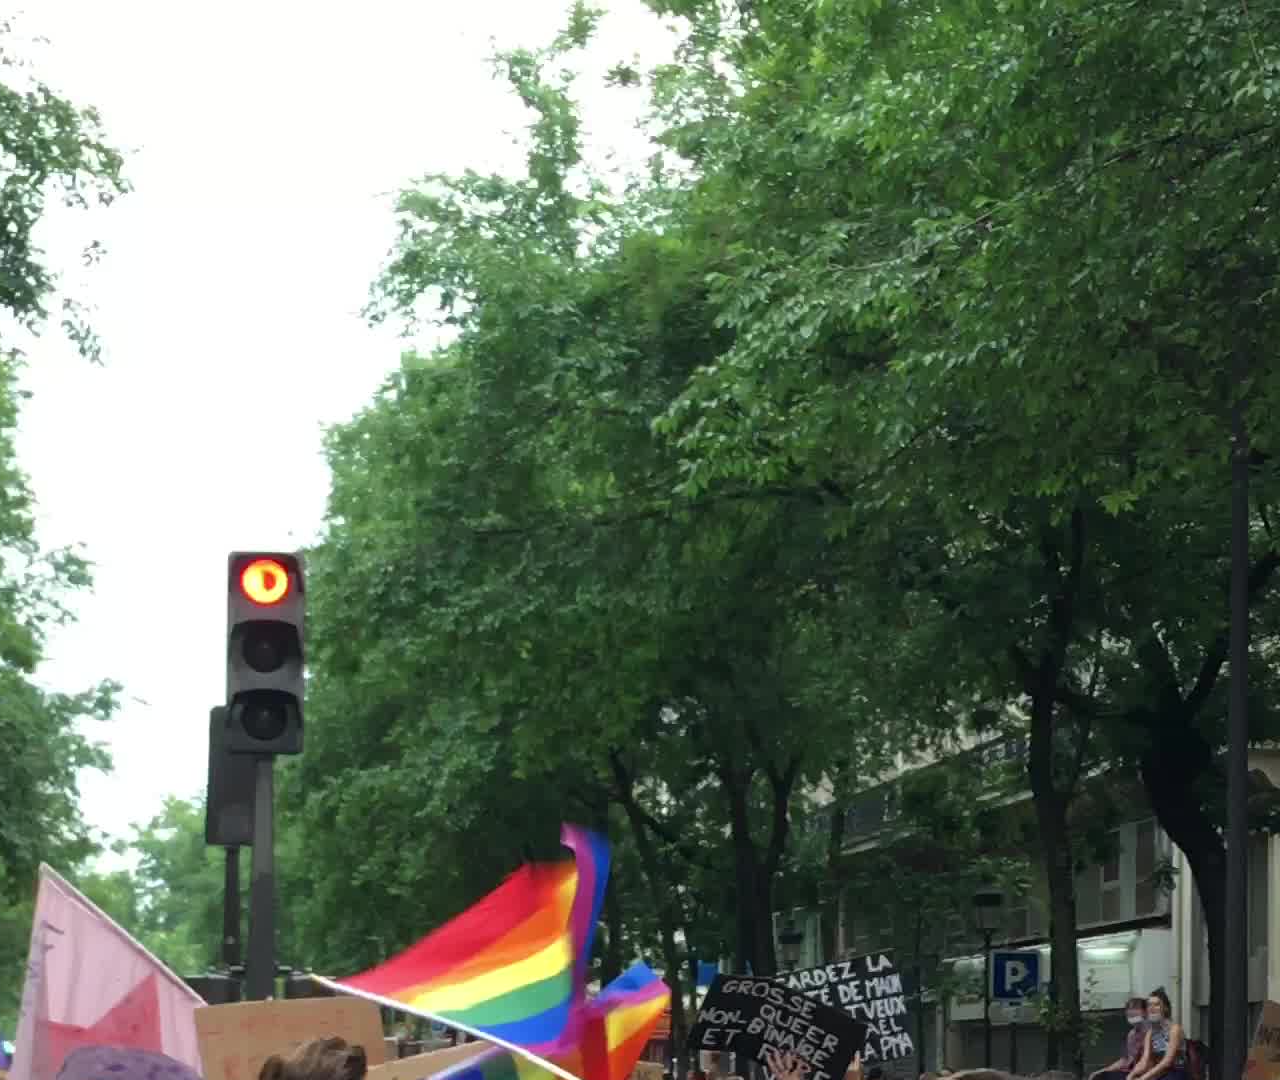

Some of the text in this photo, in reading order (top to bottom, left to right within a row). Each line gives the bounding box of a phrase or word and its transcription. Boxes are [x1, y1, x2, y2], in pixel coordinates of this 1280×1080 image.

[866, 954, 893, 973] LA
[722, 979, 817, 1019] GROSSE
[837, 980, 865, 1004] DE
[701, 1028, 742, 1046] ET
[760, 1004, 839, 1053] QUEER
[879, 1031, 915, 1061] PMA
